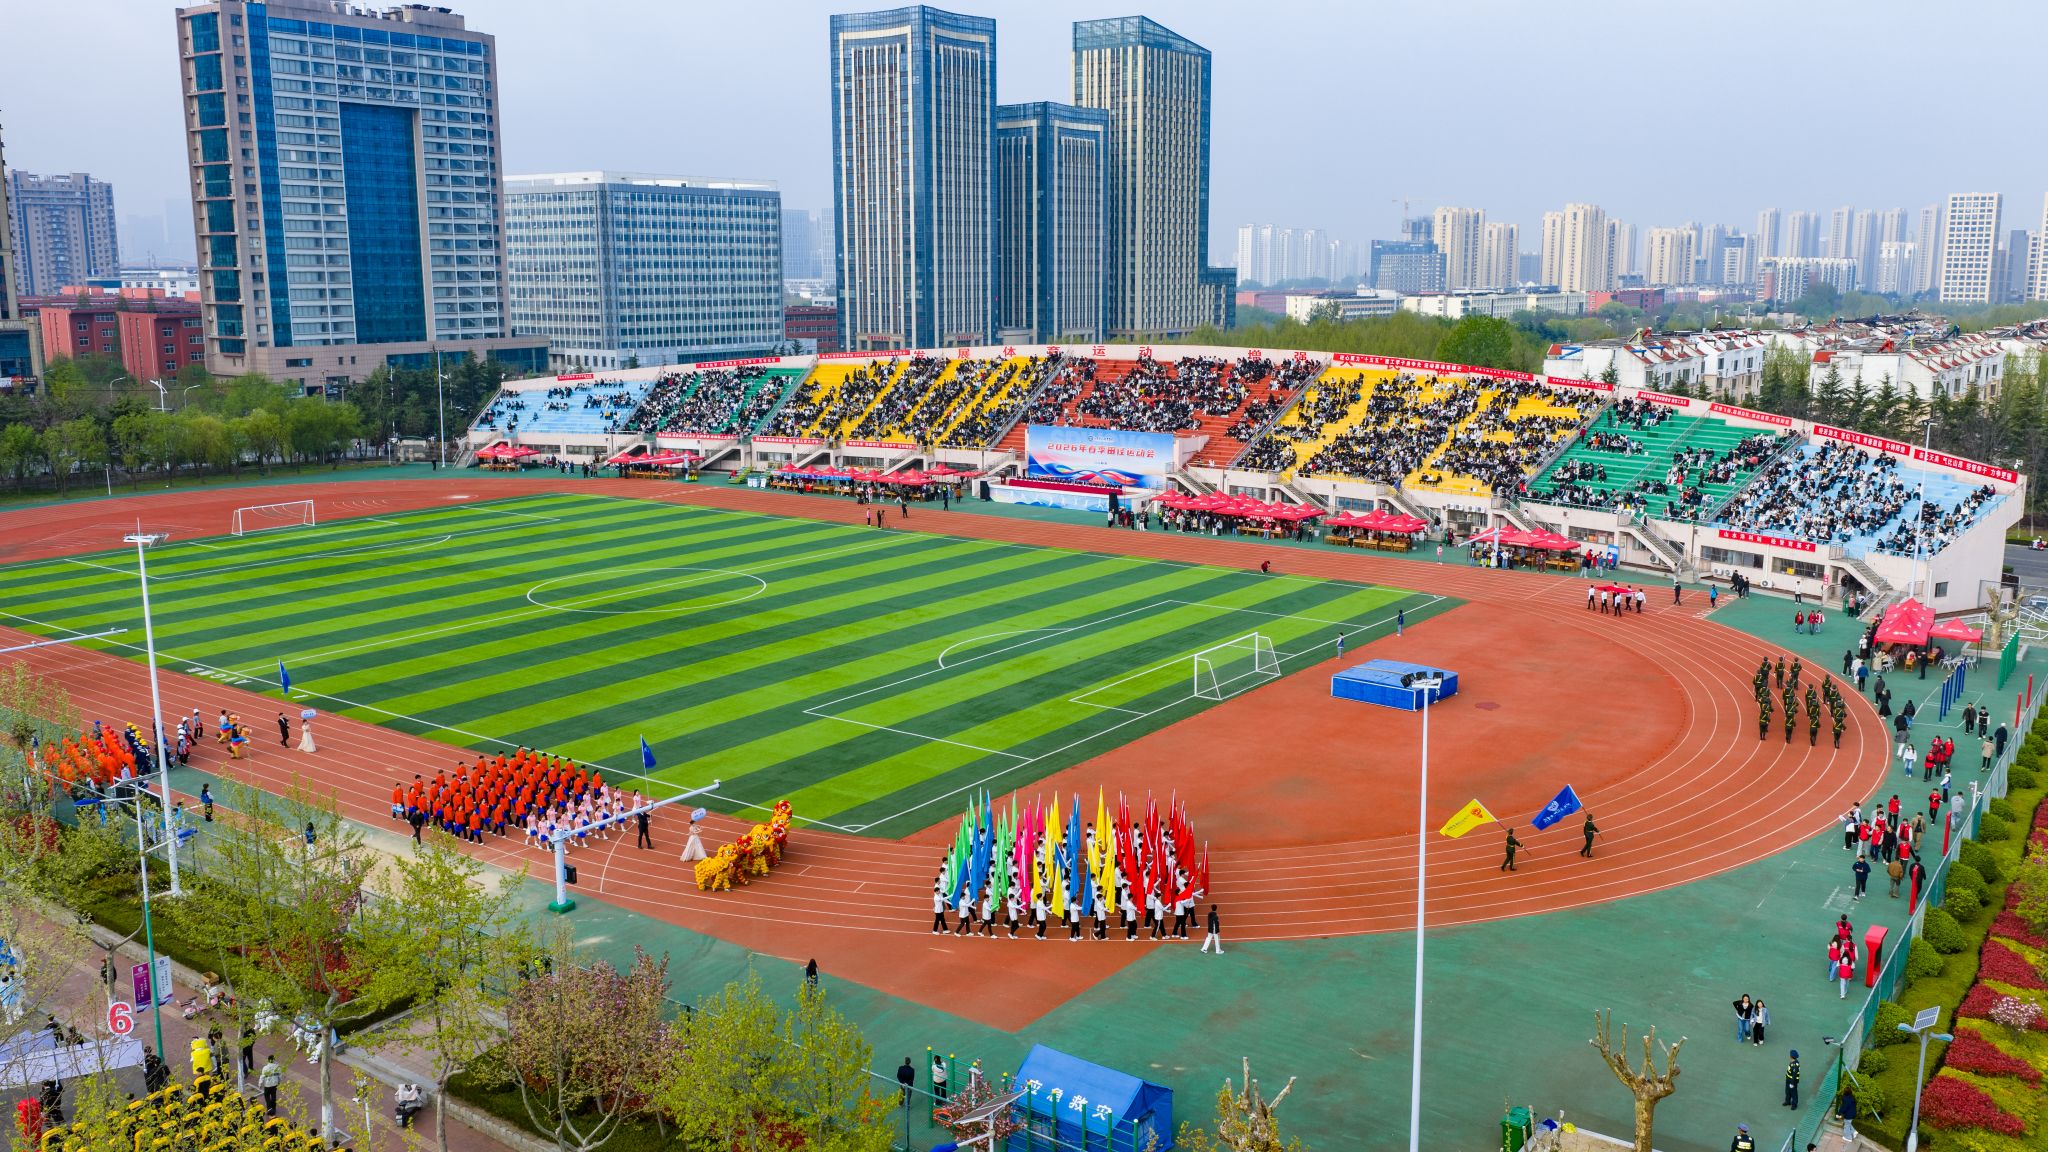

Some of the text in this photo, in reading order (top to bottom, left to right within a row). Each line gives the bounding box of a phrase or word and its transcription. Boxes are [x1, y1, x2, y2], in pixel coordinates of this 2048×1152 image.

[108, 1002, 133, 1035] 6
[1025, 1079, 1113, 1121] 应急救灾
